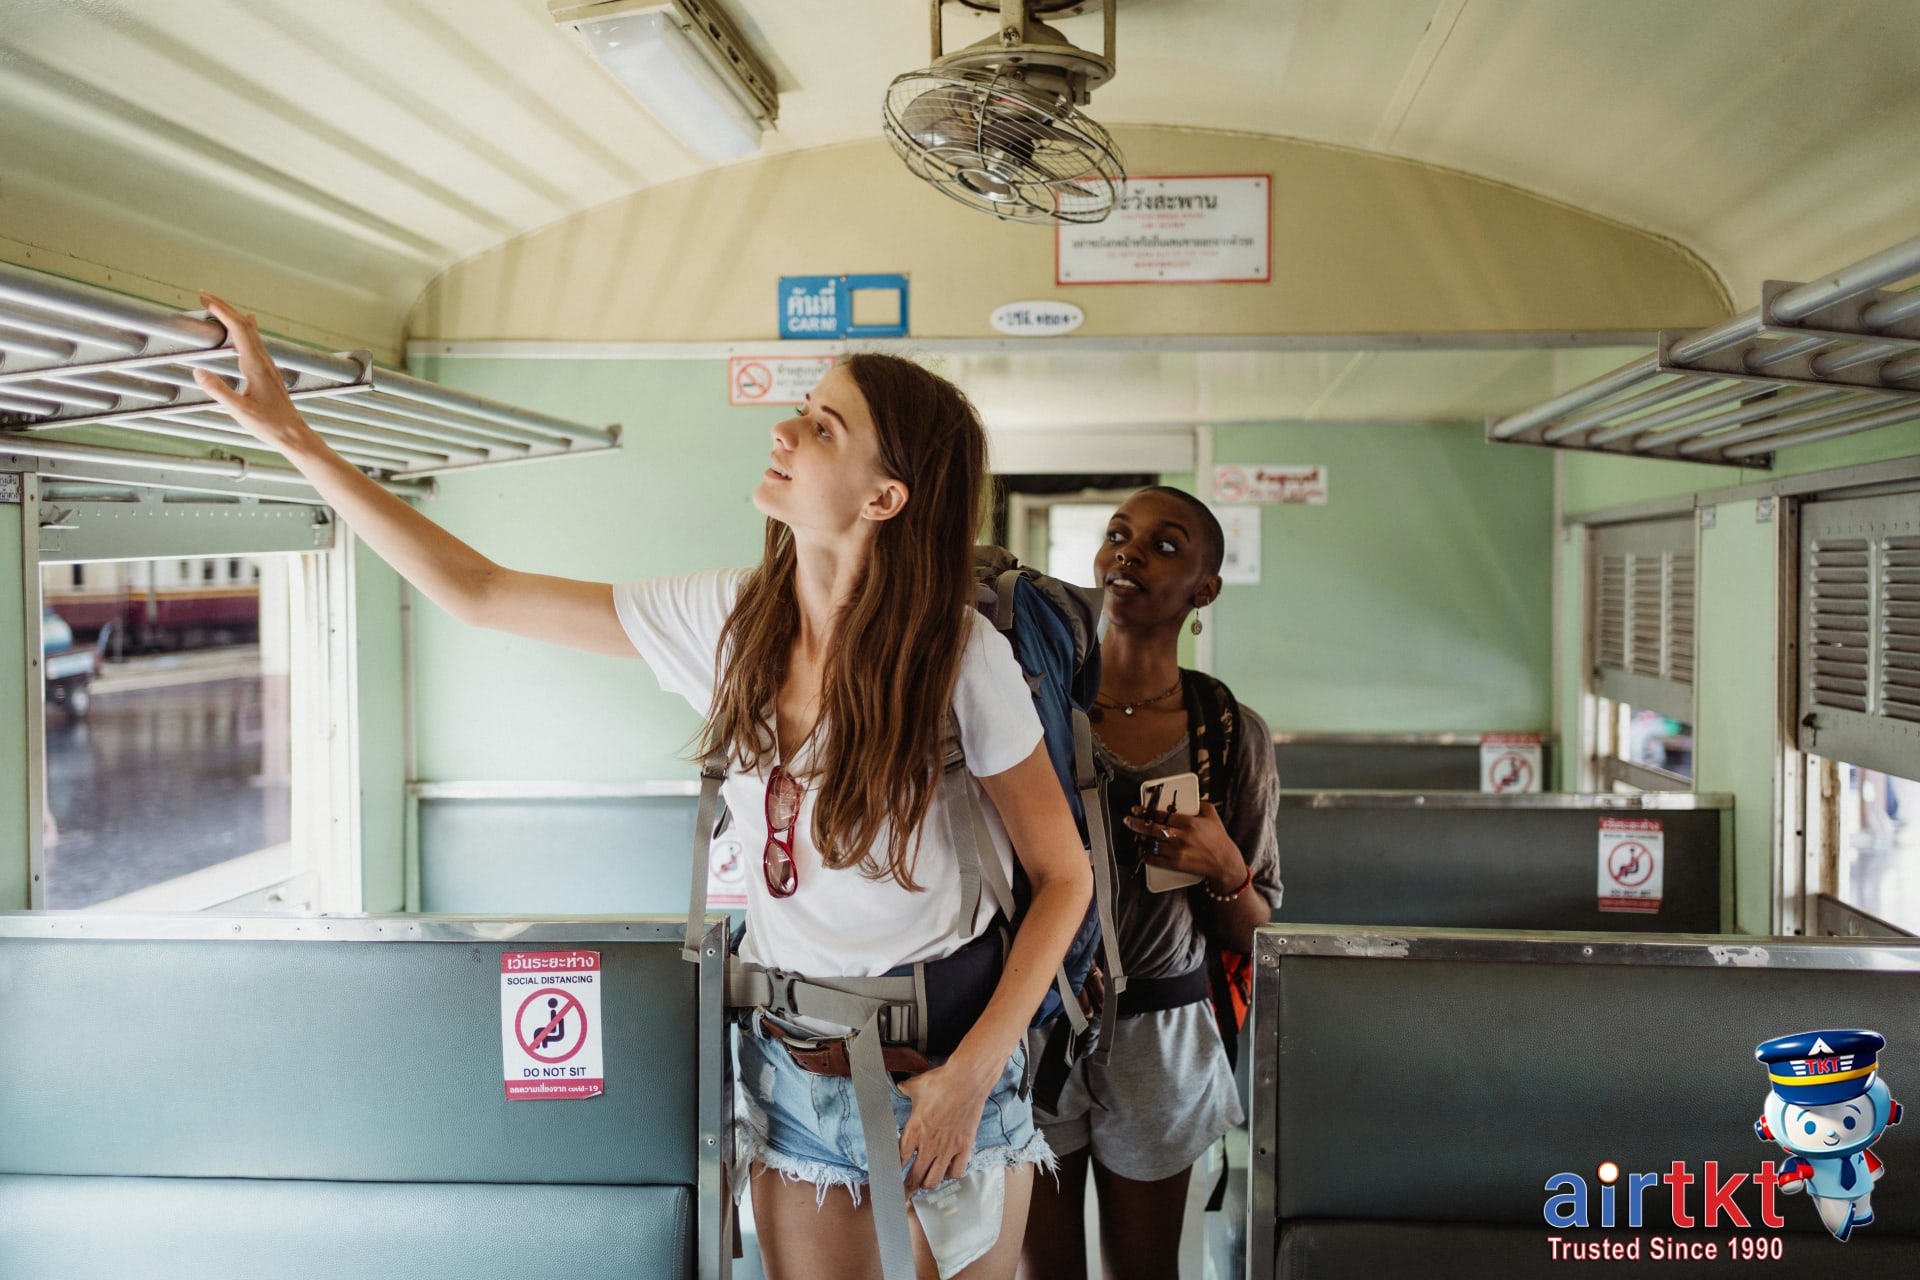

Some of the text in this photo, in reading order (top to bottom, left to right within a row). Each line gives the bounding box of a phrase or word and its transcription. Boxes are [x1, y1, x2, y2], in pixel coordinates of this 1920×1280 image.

[1113, 188, 1218, 210] ะวังสะพาน
[507, 952, 594, 970] เว้นระยะห่าง
[507, 975, 593, 985] SOCIAL DISTANCING
[523, 1066, 587, 1078] DO NOT SIT
